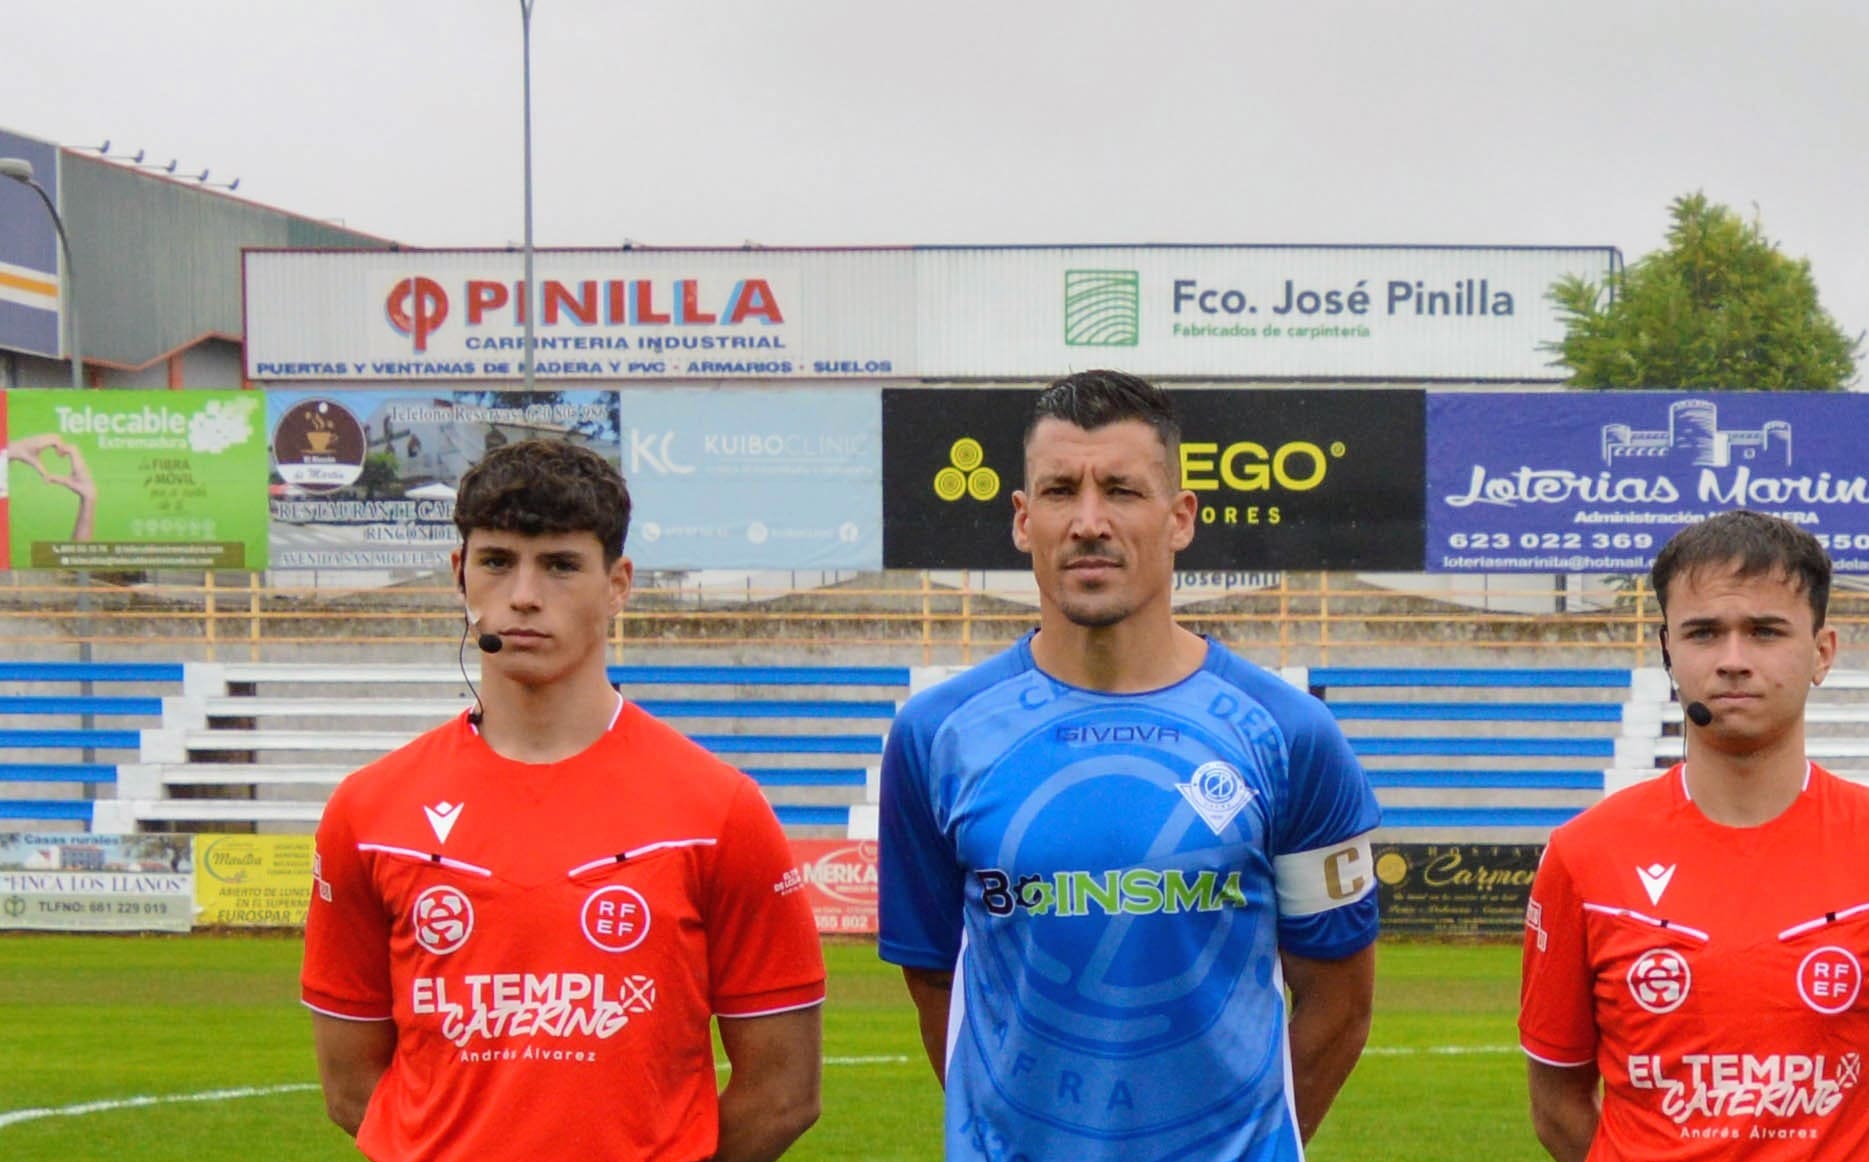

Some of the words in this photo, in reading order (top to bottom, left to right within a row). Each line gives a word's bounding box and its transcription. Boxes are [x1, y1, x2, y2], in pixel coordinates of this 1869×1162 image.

[465, 278, 784, 327] PINILLA
[1172, 279, 1258, 316] Fco.
[1272, 279, 1371, 315] José
[1387, 279, 1515, 316] Pinilla
[1172, 323, 1257, 338] Fabricados
[1262, 323, 1281, 338] de
[638, 335, 786, 350] INDUSTRIAL
[257, 363, 348, 375] PUERTAS
[353, 363, 366, 374] Y
[372, 362, 476, 374] VENTANAS
[483, 362, 511, 374] DE
[609, 361, 621, 373] Y
[628, 361, 666, 373] PVC
[687, 361, 793, 374] ARMARIOS
[813, 361, 893, 373] SUELOS
[55, 405, 186, 434] Telecable
[99, 436, 188, 449] Extremadura
[1179, 441, 1327, 491] EGO
[1201, 506, 1282, 525] ORES
[1448, 533, 1511, 550] 623
[1519, 533, 1582, 550] 022
[1592, 533, 1653, 549] 369
[1055, 725, 1181, 745] GIVOVA
[24, 833, 67, 846] Casas
[803, 862, 879, 884] MERKA
[1323, 847, 1366, 901] C
[413, 978, 452, 1014] EL
[441, 1001, 629, 1049] CATERING
[460, 1047, 517, 1064] Andrés
[523, 1045, 597, 1063] Álvarez
[1010, 1052, 1136, 1112] FRA
[1627, 1055, 1674, 1090] EL
[1661, 1083, 1844, 1124] CATERING
[1679, 1125, 1741, 1140] Andrés
[1749, 1124, 1819, 1140] Álvarez
